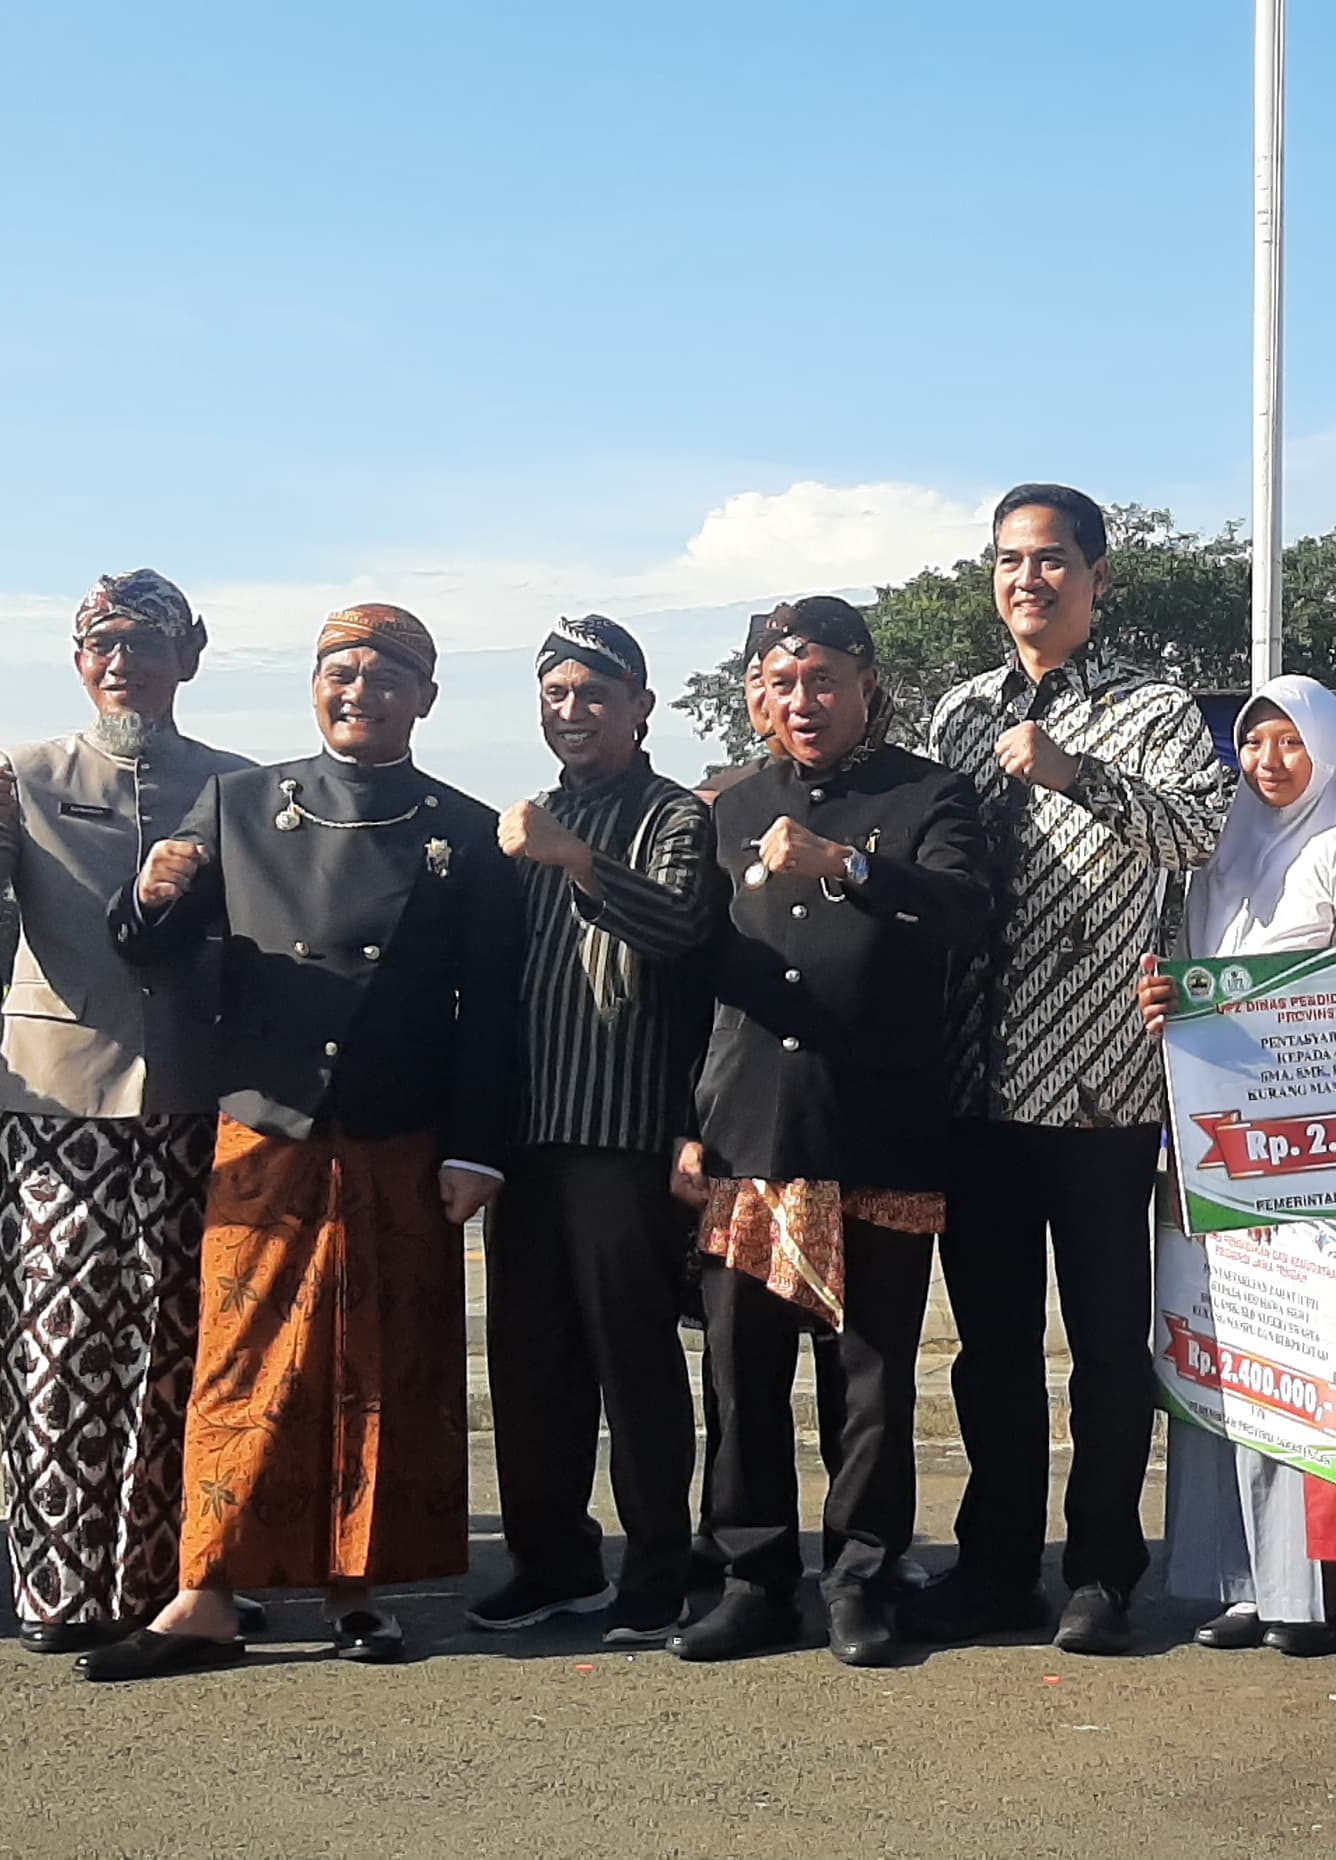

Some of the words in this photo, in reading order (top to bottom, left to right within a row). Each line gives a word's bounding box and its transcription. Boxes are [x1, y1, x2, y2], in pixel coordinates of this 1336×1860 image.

[1246, 997, 1287, 1012] DINAS
[1277, 1048, 1331, 1065] KEPADA
[1247, 1084, 1307, 1101] KURANG
[1246, 1130, 1301, 1166] Rp.
[1187, 1339, 1217, 1377] Rp.
[1220, 1350, 1334, 1423] 2.400.000,-
